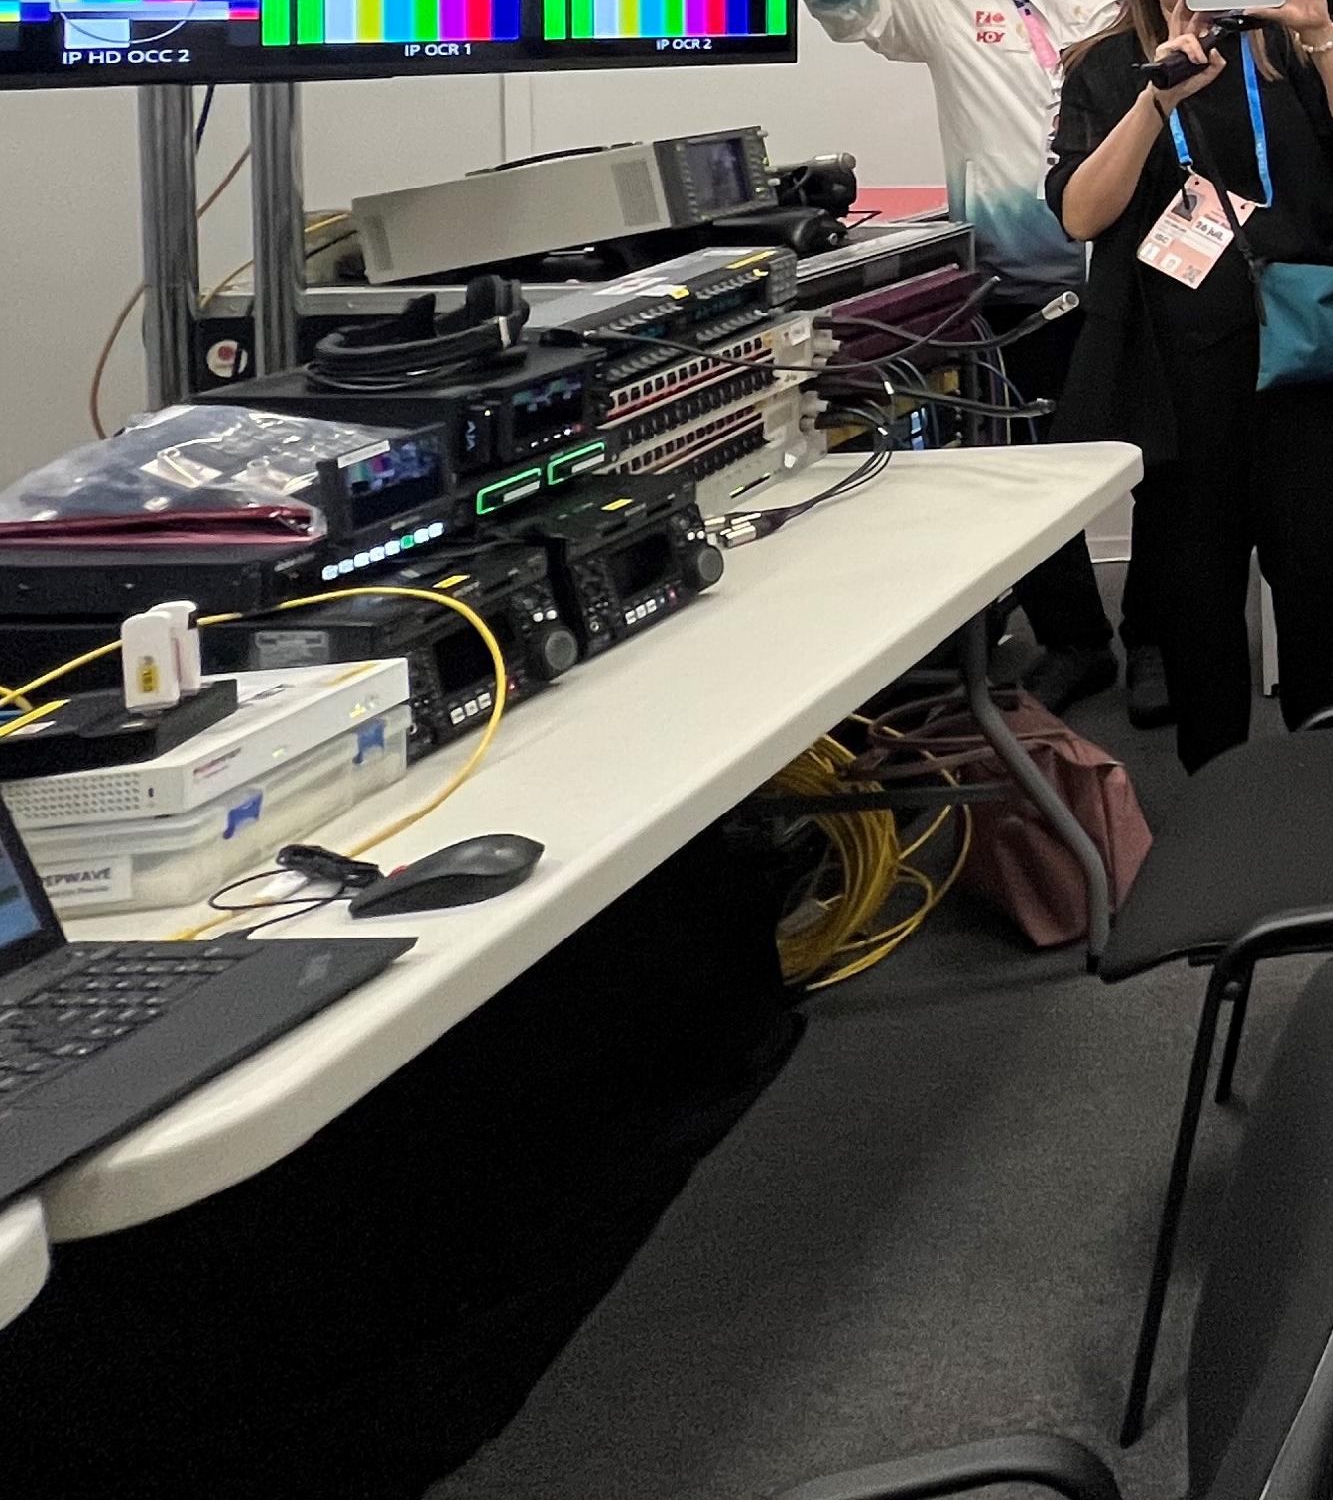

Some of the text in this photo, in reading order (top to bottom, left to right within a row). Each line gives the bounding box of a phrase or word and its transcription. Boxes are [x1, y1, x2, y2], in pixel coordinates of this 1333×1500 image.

[405, 43, 471, 56] IP OCR 1
[657, 38, 712, 50] IP OCR 2
[62, 50, 190, 65] IP HD OCC 2
[40, 867, 110, 888] EPWAVE
